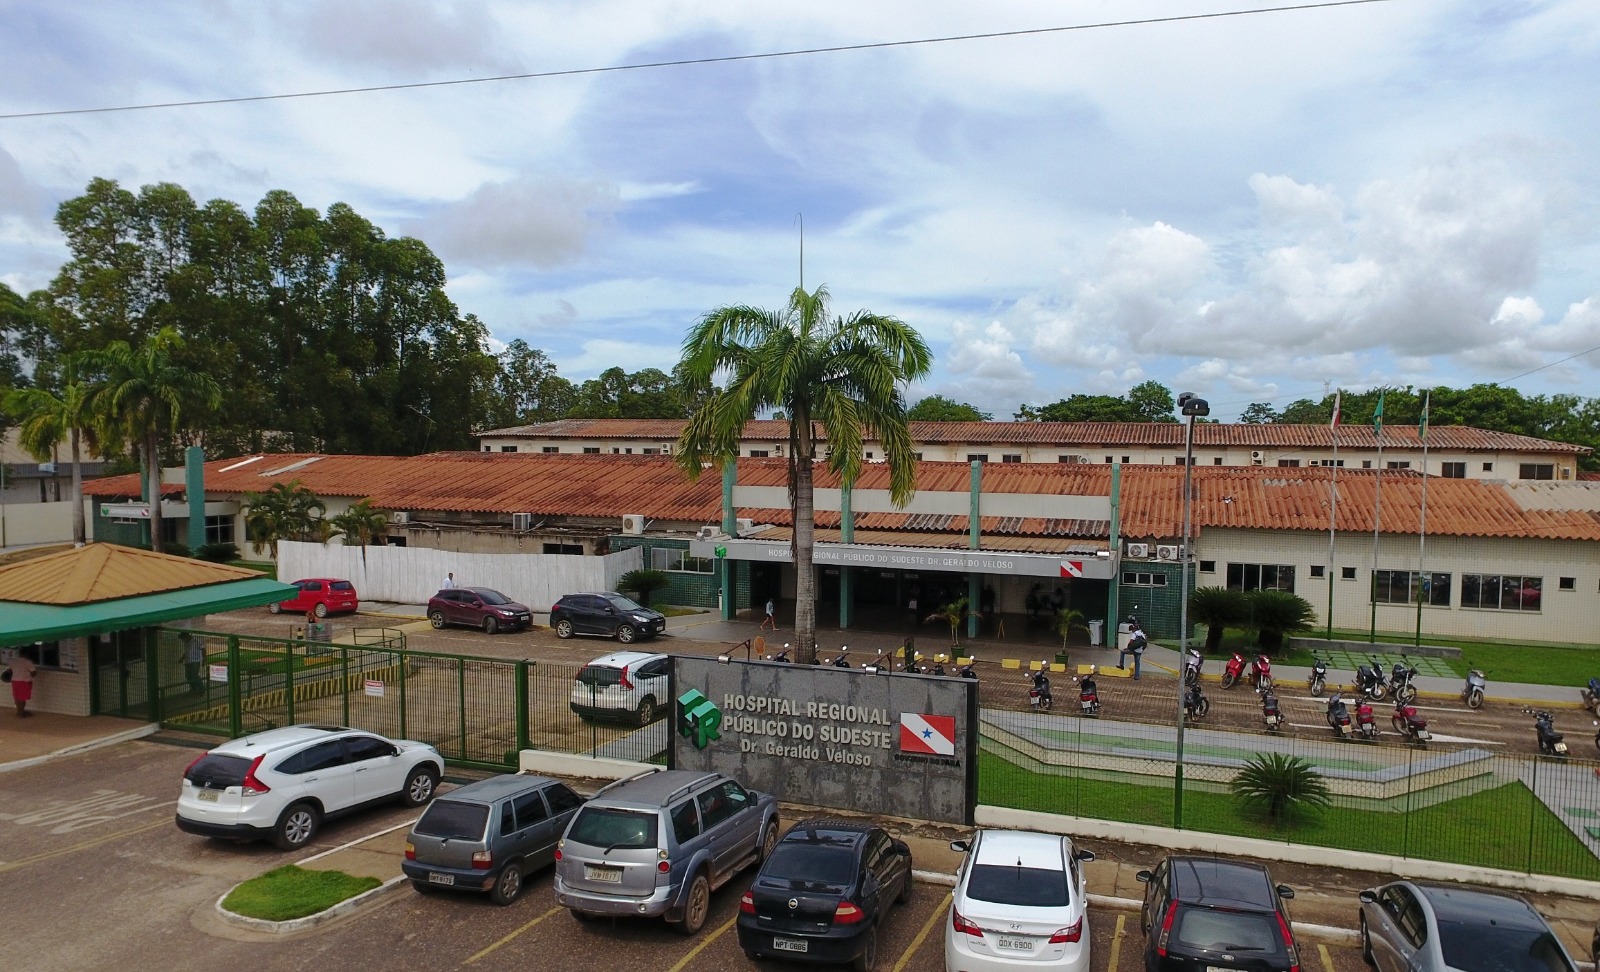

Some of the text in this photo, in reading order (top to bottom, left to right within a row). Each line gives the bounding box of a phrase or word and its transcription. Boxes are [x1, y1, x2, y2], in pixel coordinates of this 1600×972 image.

[877, 554, 888, 563] DO
[891, 555, 925, 565] SUDESTE
[983, 560, 1013, 569] VELOSO
[724, 693, 891, 726] HOSPITAL REGIONAL
[723, 713, 892, 749] PÚBLICO DO SUDESTE
[741, 738, 872, 767] Dr Geraldo Veloso
